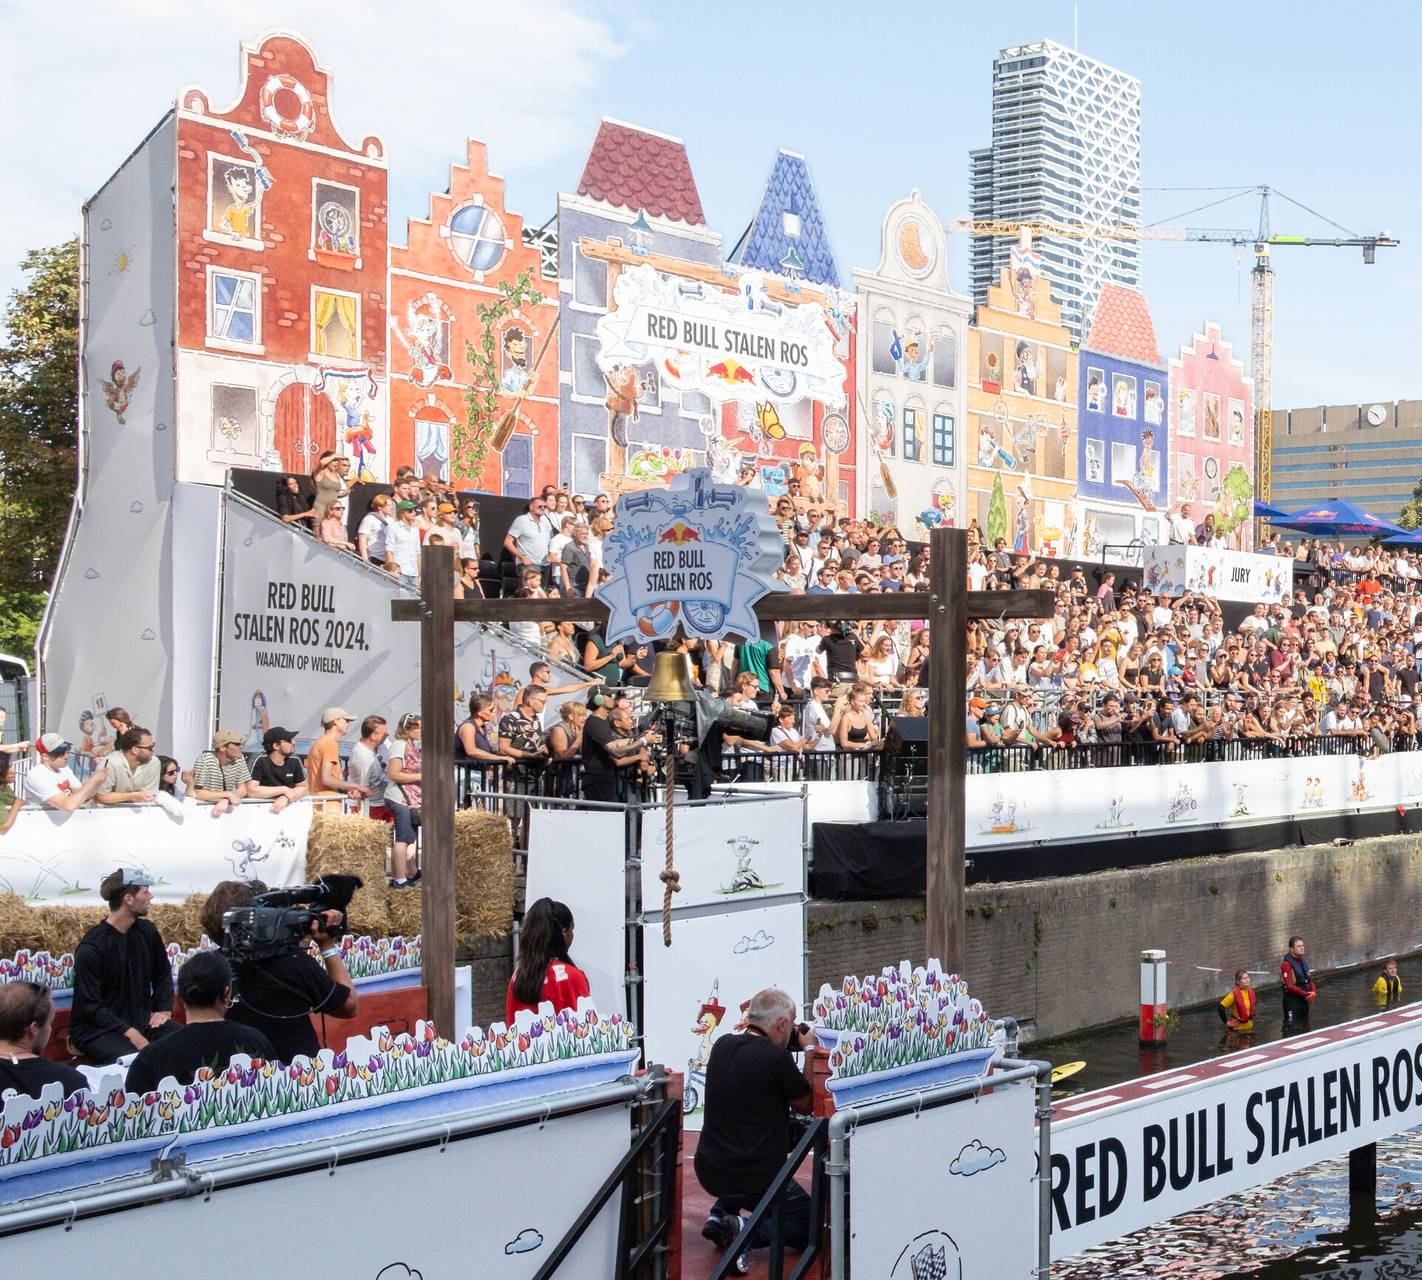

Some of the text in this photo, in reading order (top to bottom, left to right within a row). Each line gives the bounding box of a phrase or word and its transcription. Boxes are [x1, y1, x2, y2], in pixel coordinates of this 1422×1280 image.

[647, 313, 808, 367] RED BULL STALEN ROS
[653, 549, 706, 569] RED BULL
[646, 572, 713, 592] STALEN ROS
[1230, 567, 1251, 583] JURY
[267, 581, 335, 613] RED BULL
[234, 612, 369, 651] STALEN ROS 2024.
[255, 651, 344, 674] WAANZIN OP WIELEN.
[1050, 1137, 1128, 1235] RED
[1143, 1102, 1233, 1203] BULL
[1245, 1062, 1361, 1165] STALEN
